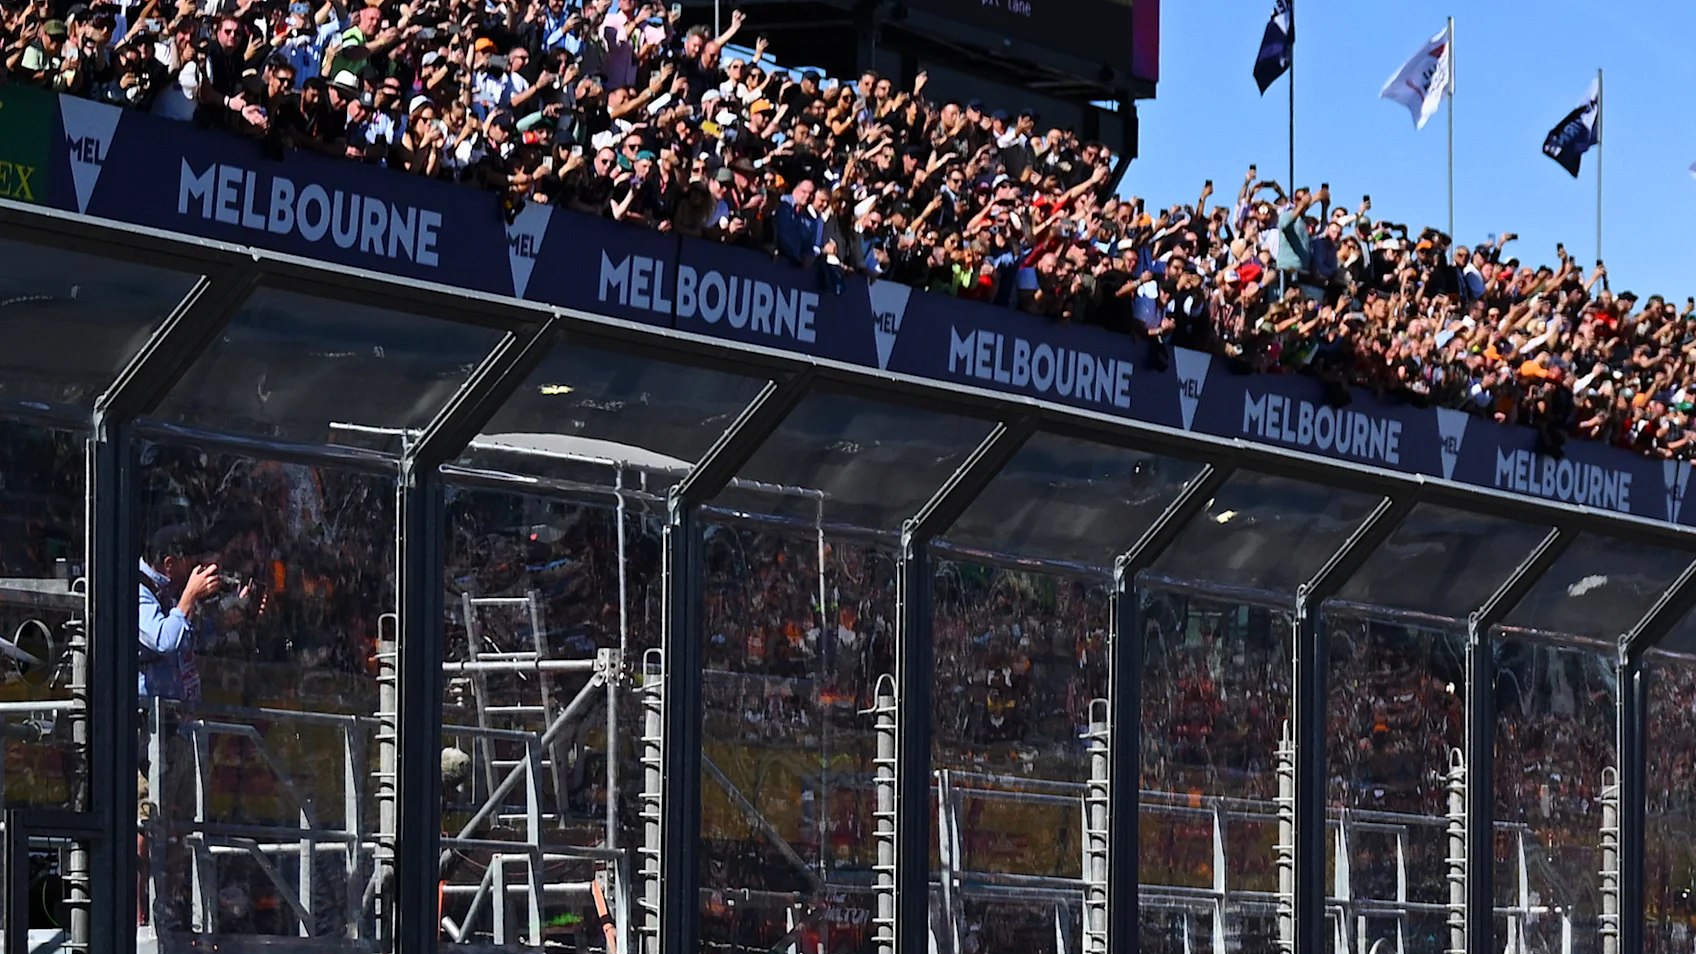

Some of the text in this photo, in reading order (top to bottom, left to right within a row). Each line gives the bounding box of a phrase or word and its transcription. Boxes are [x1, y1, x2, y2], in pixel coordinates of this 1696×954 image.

[66, 133, 106, 166] MEL
[178, 155, 442, 267] MELBOURNE
[505, 228, 537, 260] MEL
[599, 248, 819, 343] MELBOURNE
[872, 309, 901, 336] MEL
[948, 328, 1134, 408] MELBOURNE
[1177, 376, 1201, 400] MEL
[1243, 389, 1402, 464] MELBOURNE
[1495, 445, 1632, 512] MELBOURNE
